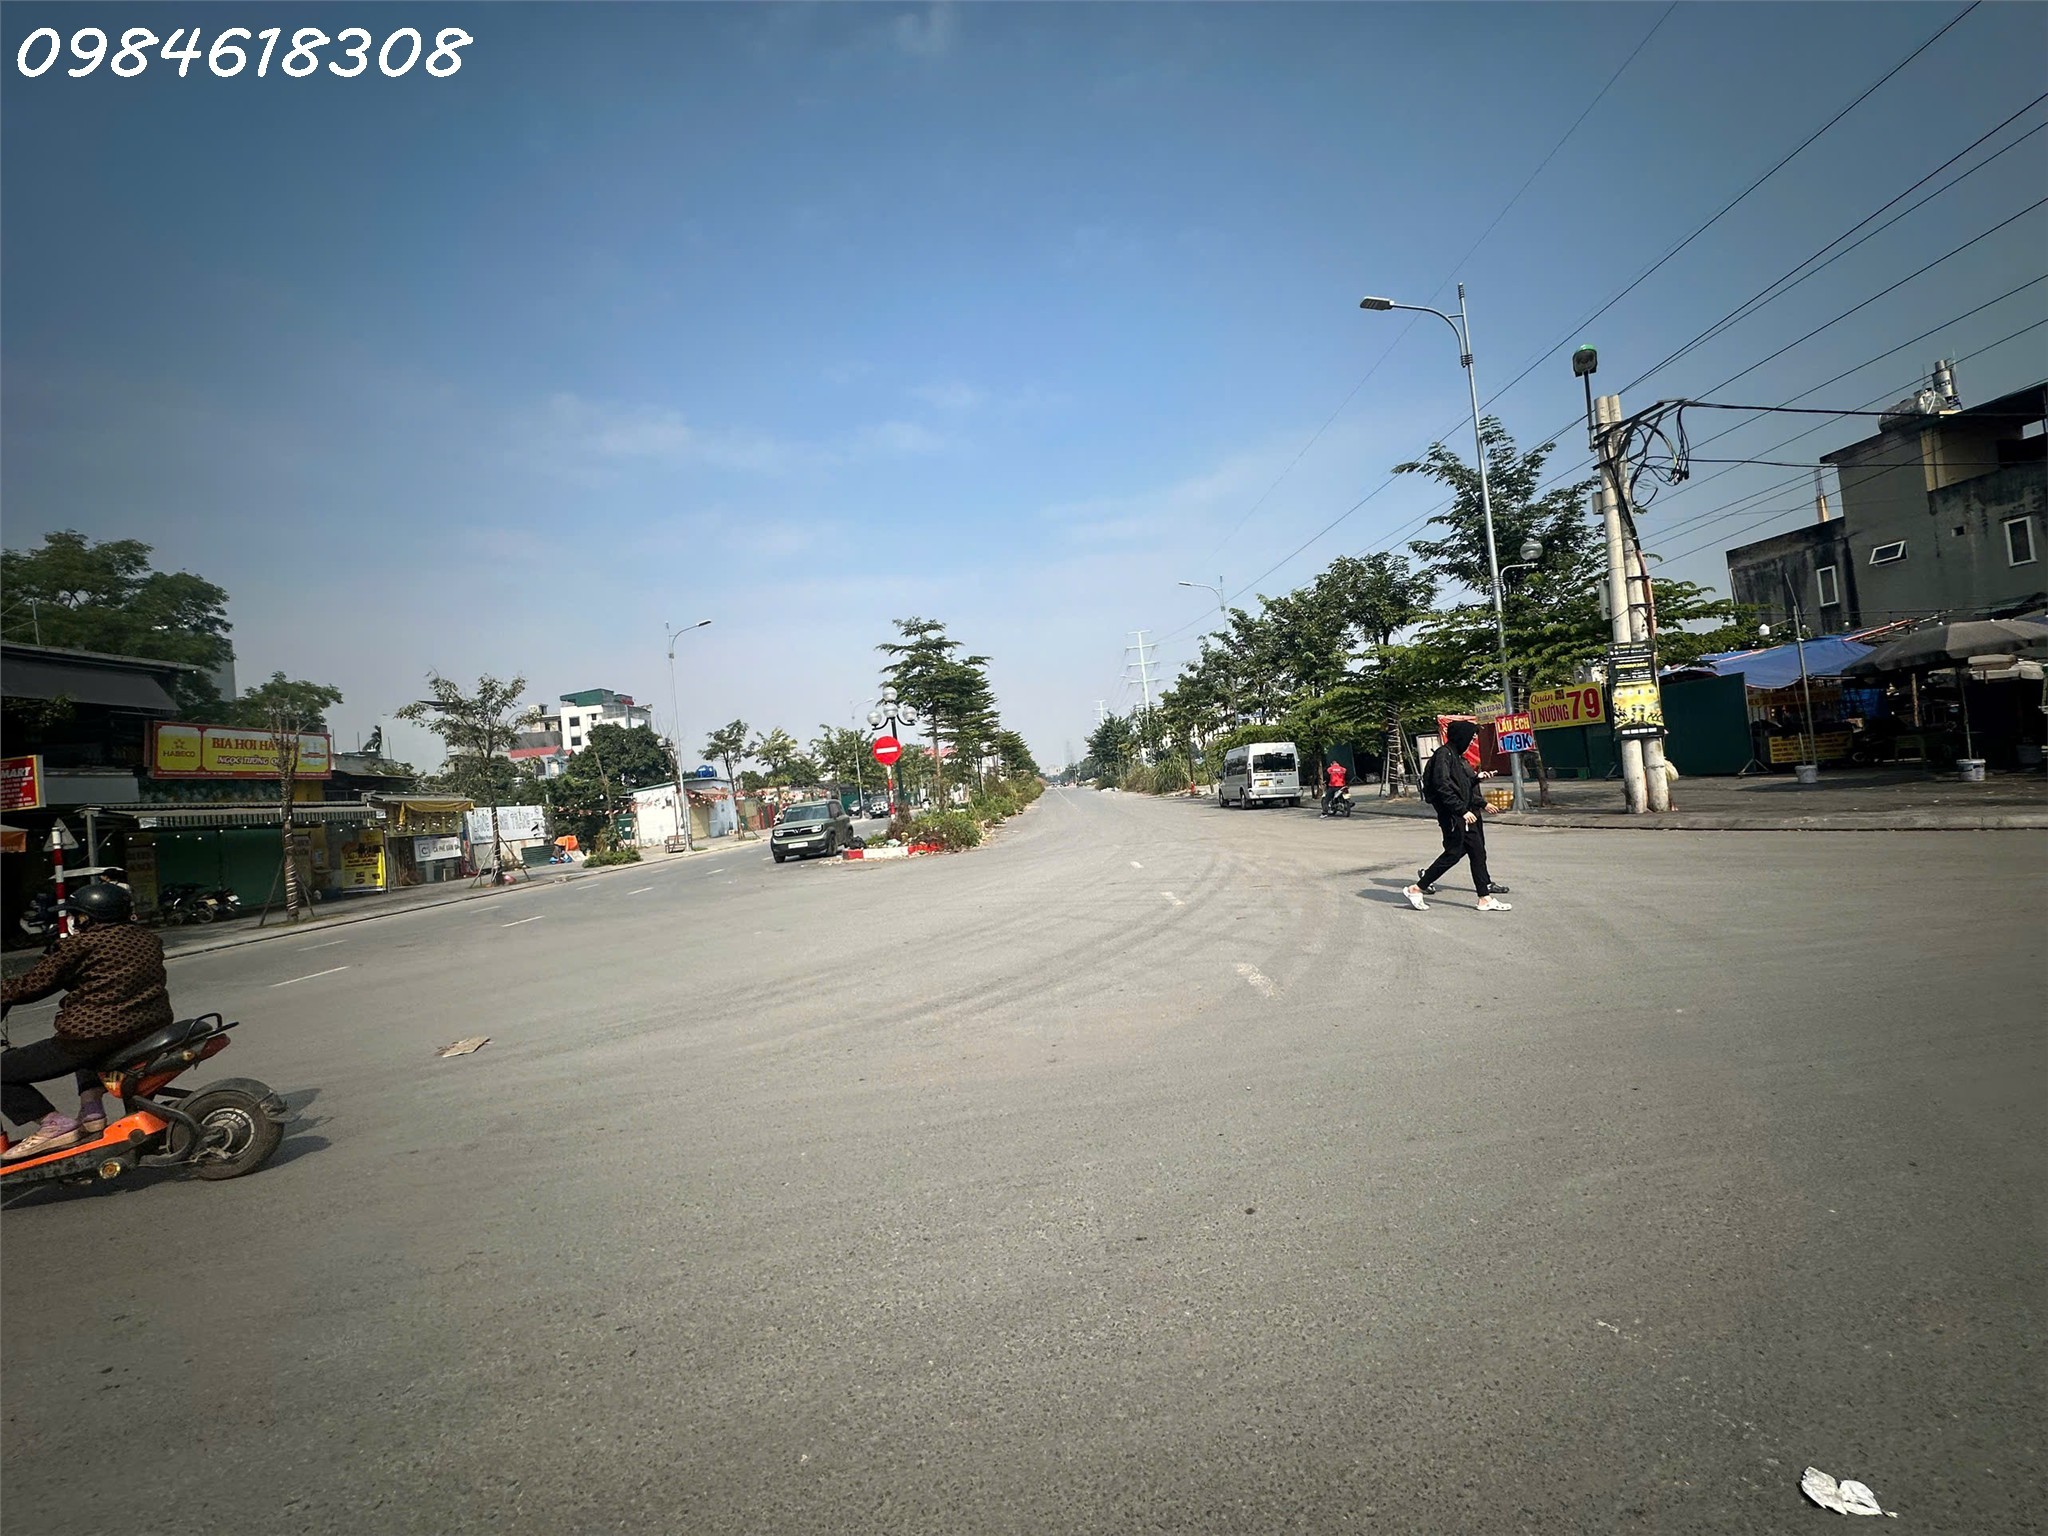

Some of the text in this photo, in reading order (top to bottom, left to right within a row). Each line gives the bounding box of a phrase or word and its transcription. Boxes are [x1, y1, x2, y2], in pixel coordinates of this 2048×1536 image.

[1566, 688, 1600, 720] 79
[212, 737, 232, 749] BIA
[1499, 733, 1532, 751] 179K
